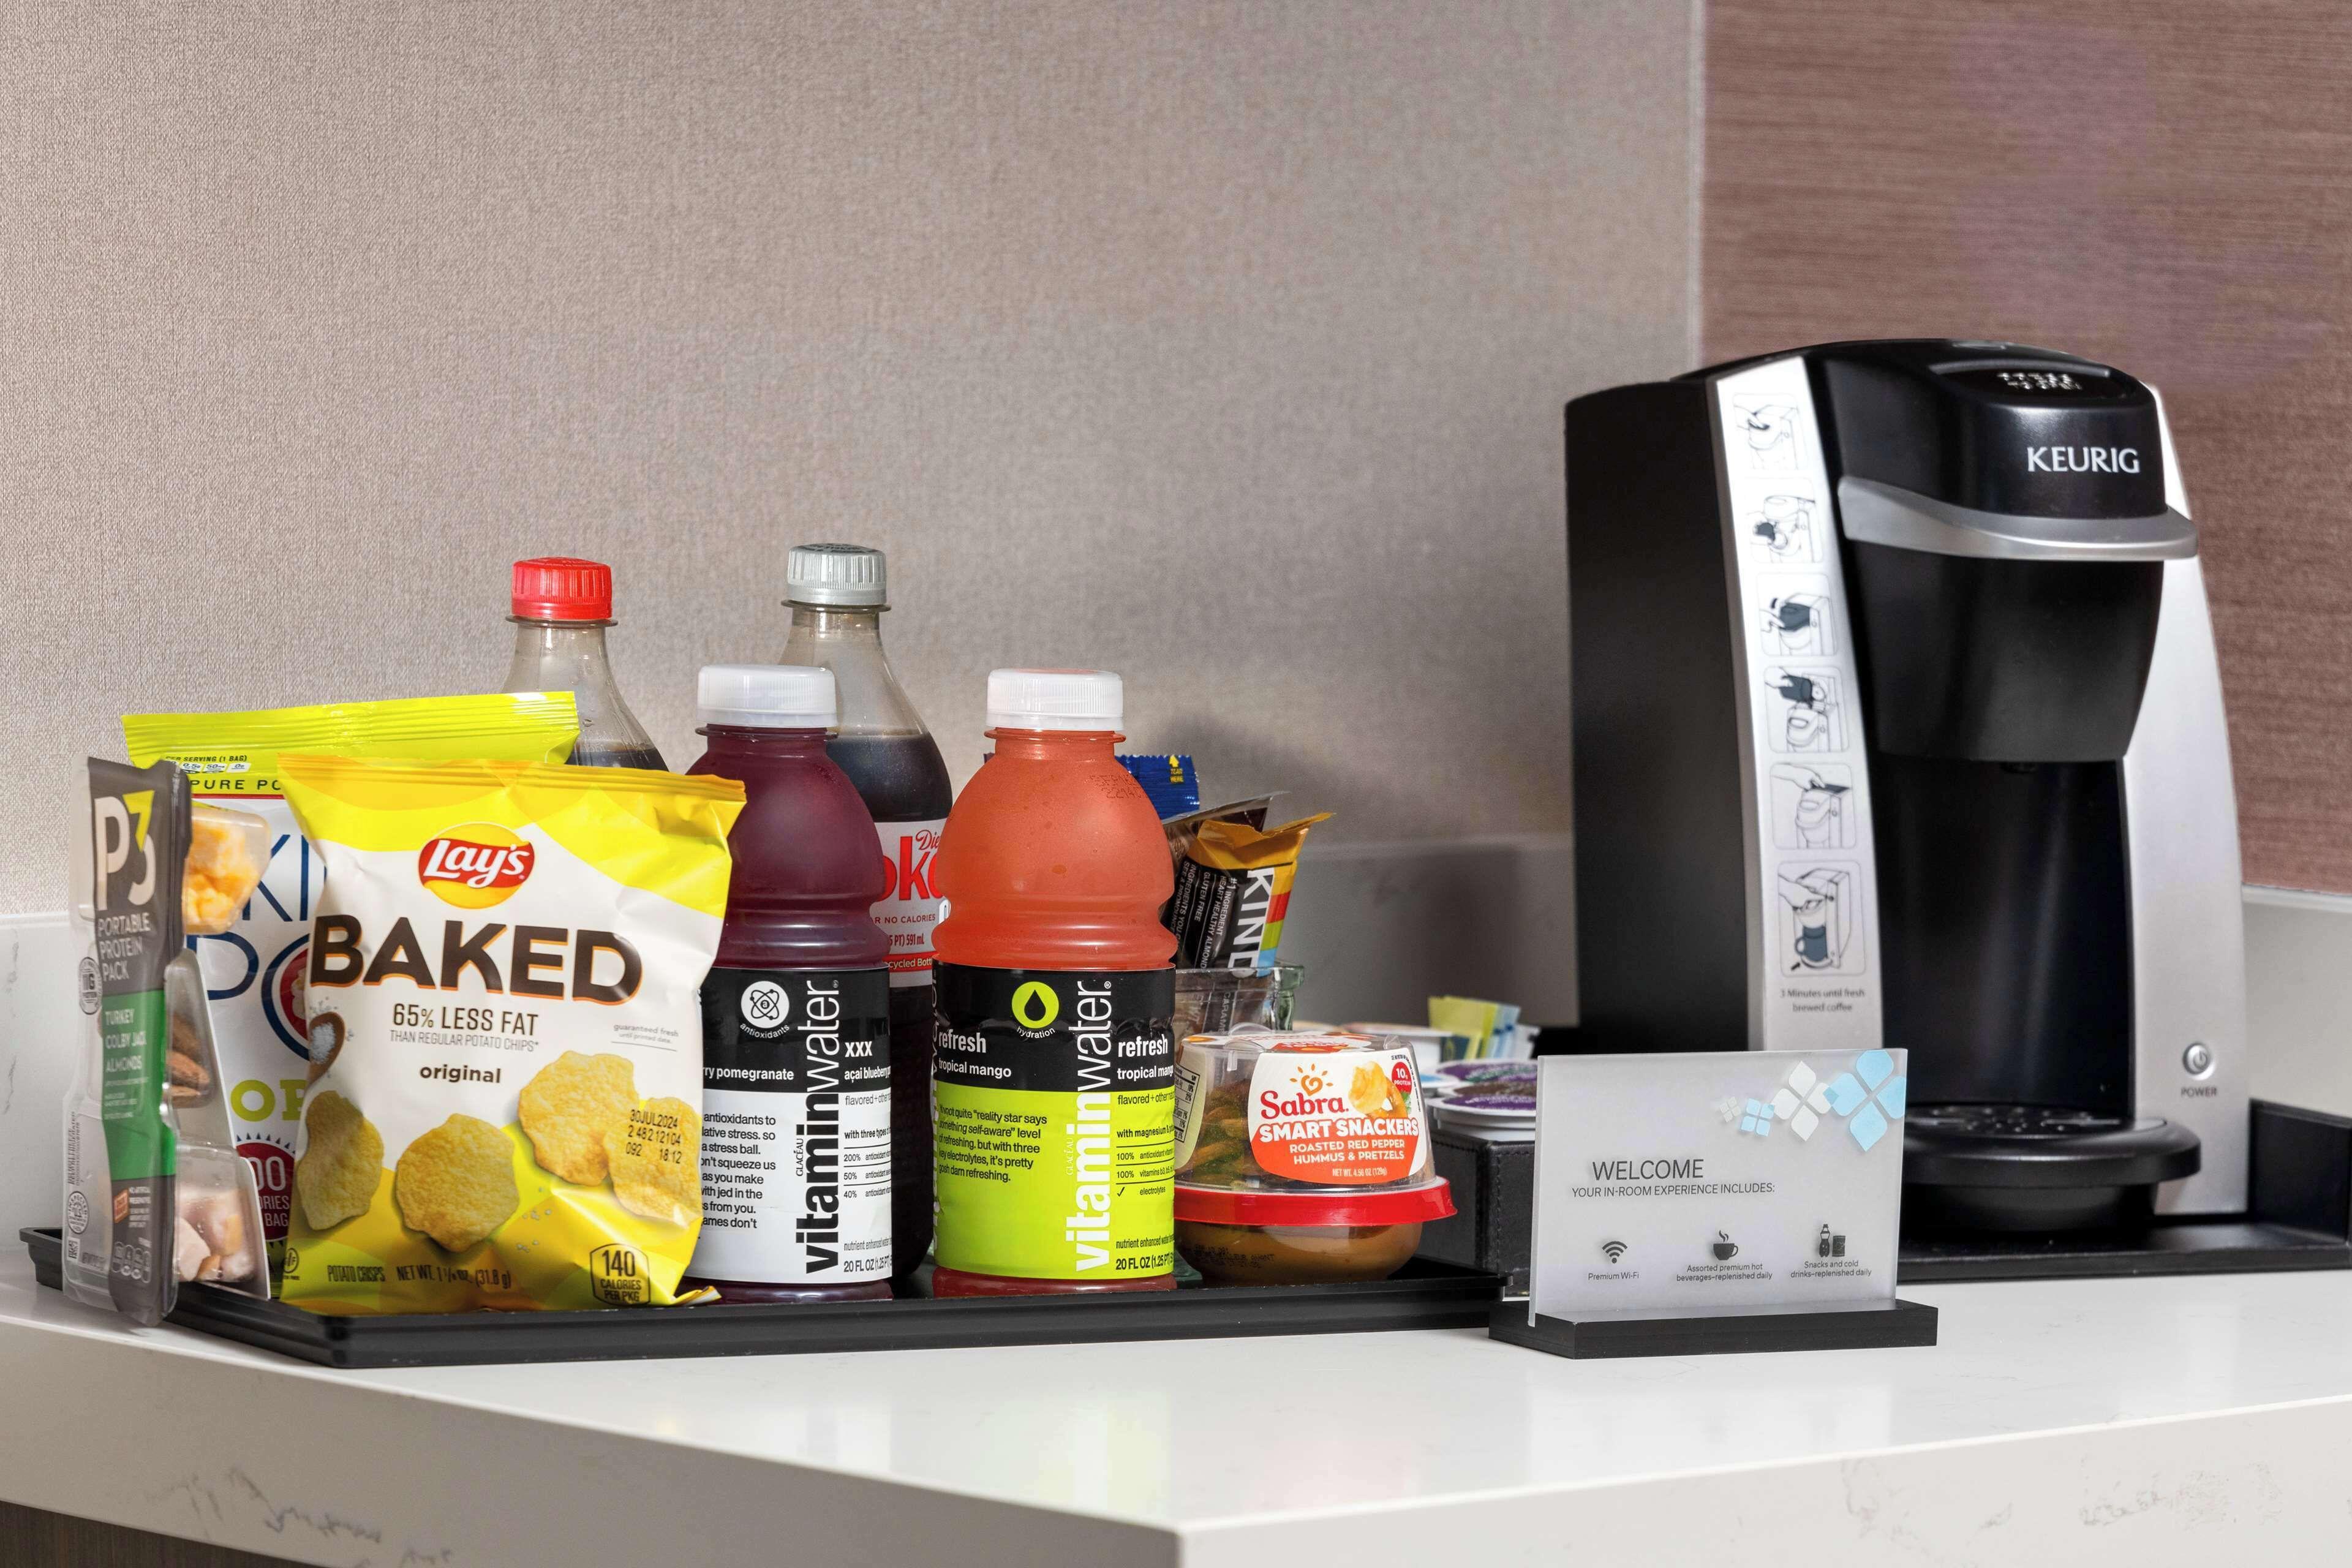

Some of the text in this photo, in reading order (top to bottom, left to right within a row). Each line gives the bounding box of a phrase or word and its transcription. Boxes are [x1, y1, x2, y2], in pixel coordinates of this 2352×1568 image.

[2027, 447, 2140, 473] KEURIG
[915, 829, 941, 850] Die
[94, 790, 156, 911] P3
[423, 839, 530, 888] Lay's
[877, 836, 943, 902] ok
[1179, 864, 1197, 915] INGREDIENTS
[1194, 872, 1211, 922] GLUTEN FREE
[1215, 877, 1238, 936] #1 INGREDIENT
[97, 912, 152, 937] PORTABLE
[901, 914, 936, 924] CALORIES
[906, 934, 916, 945] 591
[1200, 901, 1221, 971] HEALTHY ALMOND
[100, 936, 144, 960] PROTEIN
[310, 914, 643, 1006] BAKED
[889, 958, 915, 969] cycled
[102, 960, 130, 982] PACK
[1787, 989, 1821, 997] Minutes
[1823, 989, 1842, 997] until
[1844, 989, 1865, 997] fresh
[105, 1009, 135, 1025] TURKEY
[393, 1003, 539, 1036] 65% LESS FAT
[613, 1025, 658, 1033] guaranteed
[739, 1023, 790, 1039] antioxidants
[1016, 1026, 1056, 1039] hydration
[105, 1032, 131, 1049] COLBY
[390, 1030, 416, 1042] THAN
[418, 1033, 463, 1046] REGULAR
[465, 1035, 501, 1049] POTATO
[938, 1028, 987, 1054] refresh
[1118, 1034, 1168, 1058] refresh
[845, 1041, 873, 1057] xxx
[105, 1055, 143, 1072] ALMONDS
[938, 1057, 1012, 1079] tropical mango
[420, 1064, 502, 1084] original
[717, 1067, 794, 1082] pomegranate
[845, 1069, 862, 1083] açai
[1117, 1065, 1157, 1081] tropical
[845, 1092, 873, 1106] flavored
[1118, 1093, 1150, 1105] flavored
[2180, 1087, 2217, 1097] POWER
[630, 1109, 678, 1129] 30JUL2024
[704, 1113, 776, 1125] antioxidants to
[956, 1109, 973, 1119] quite
[1004, 1114, 1023, 1123] star
[1023, 1115, 1047, 1126] says
[728, 1129, 761, 1140] stress.
[796, 980, 840, 1274] vitaminwater
[845, 1128, 876, 1139] with three
[939, 1120, 967, 1134] something
[1017, 1128, 1041, 1139] level
[1066, 981, 1112, 1272] vitaminwater
[1117, 1128, 1166, 1138] with magnesium
[1259, 1118, 1419, 1142] SMART SNACKERS
[625, 1142, 643, 1156] 092
[709, 1143, 761, 1155] stress ball.
[943, 1135, 1040, 1153] refreshing. but with three
[1289, 1139, 1405, 1153] ROASTED RED PEPPER
[718, 1158, 776, 1170] squeeze us
[794, 1139, 804, 1177] GLACÉAU
[947, 1150, 1033, 1170] electrolytes, it's pretty
[1294, 1150, 1404, 1165] HUMMUS & PRETZELS
[843, 1172, 858, 1180] 50%
[951, 1166, 1011, 1183] darn refreshing.
[1593, 1159, 1704, 1180] WELCOME
[714, 1174, 764, 1184] you make
[717, 1188, 763, 1199] jed in the
[1140, 1186, 1166, 1196] electrolytes
[1572, 1183, 1776, 1197] YOUR IN-ROOM EXPERIENCE INCLUDES:
[710, 1202, 733, 1212] from
[734, 1204, 756, 1215] you.
[266, 1213, 288, 1226] BAG
[730, 1218, 757, 1229] don't
[844, 1240, 865, 1251] nutrient
[1116, 1235, 1161, 1249] nutrient enhanced
[601, 1250, 636, 1277] 140
[843, 1259, 875, 1272] 20 FL OZ
[1115, 1256, 1150, 1270] 20 FL OZ
[1719, 1265, 1750, 1274] premium
[327, 1265, 386, 1283] POTATO CRISPS
[396, 1265, 415, 1281] NET
[1757, 1272, 1773, 1280] daily
[1855, 1268, 1872, 1277] daily
[600, 1279, 642, 1291] CALORIES
[604, 1290, 640, 1302] PER PKG
